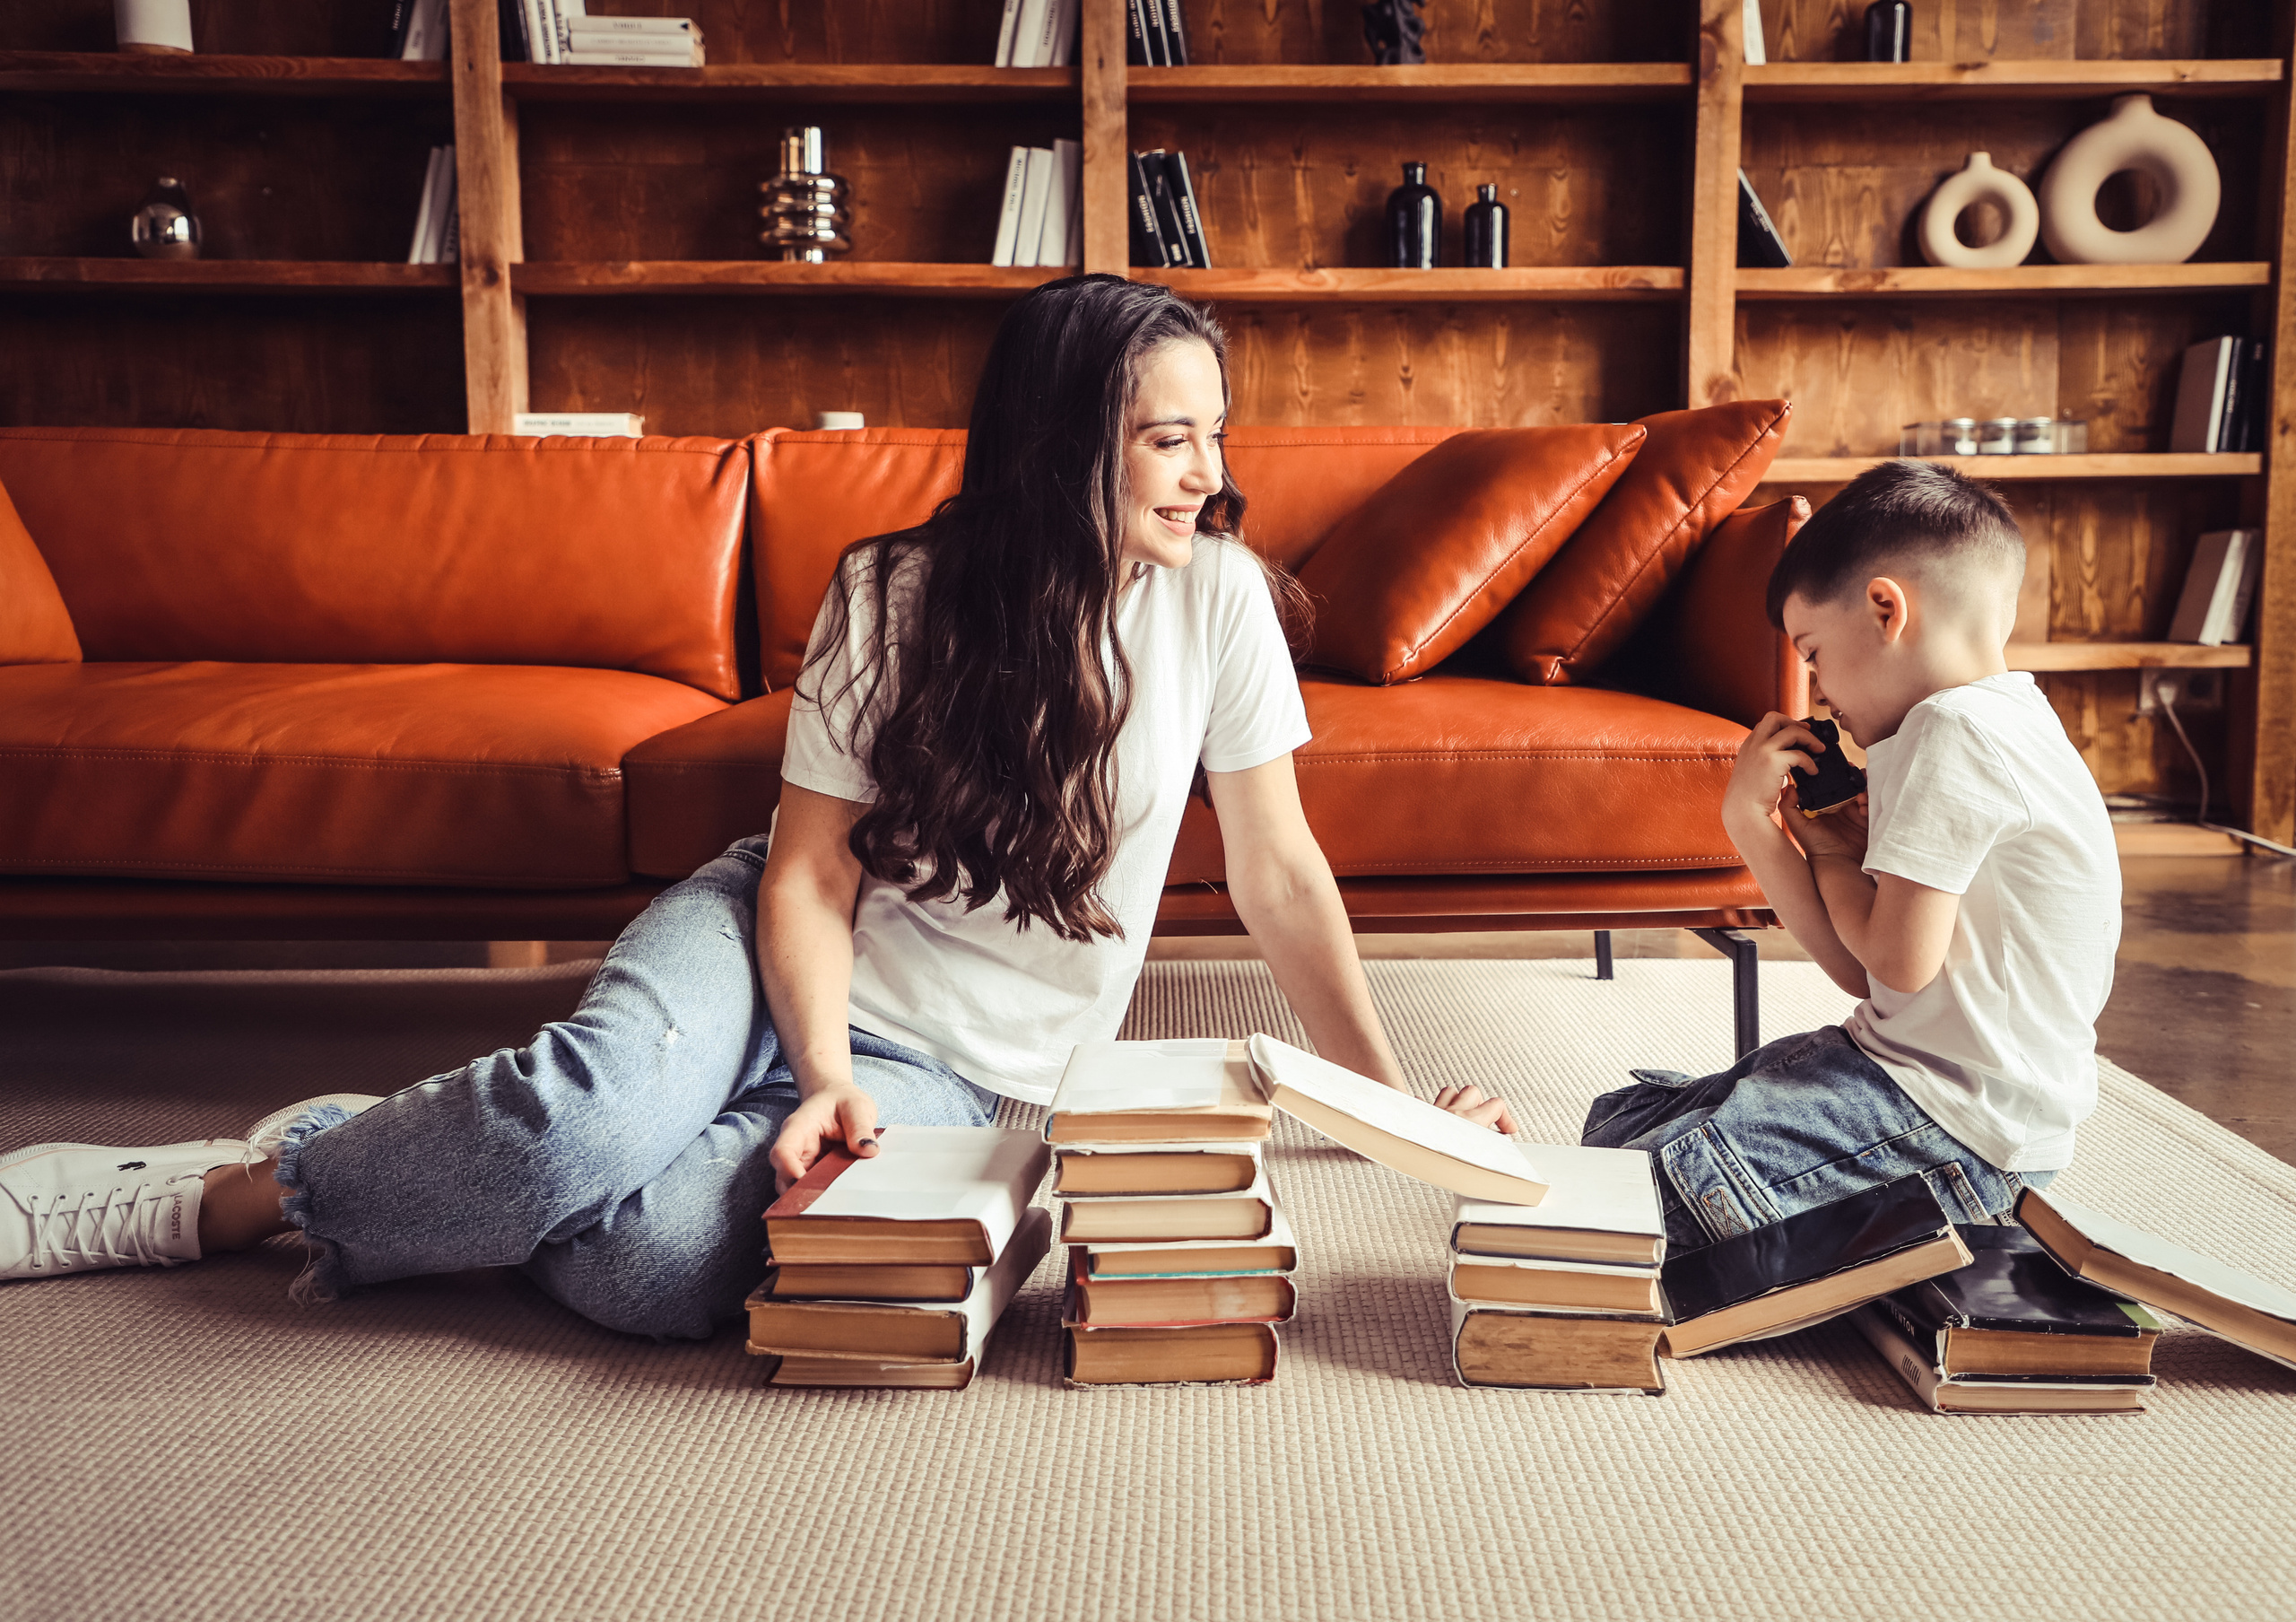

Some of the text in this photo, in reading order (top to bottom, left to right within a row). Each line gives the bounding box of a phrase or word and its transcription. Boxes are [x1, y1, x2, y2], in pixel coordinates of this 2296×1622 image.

[1137, 194, 1155, 233] FASHION
[1179, 195, 1196, 234] FASHION
[171, 1195, 183, 1240] LACOSTE
[1891, 1304, 1915, 1337] NEWTON
